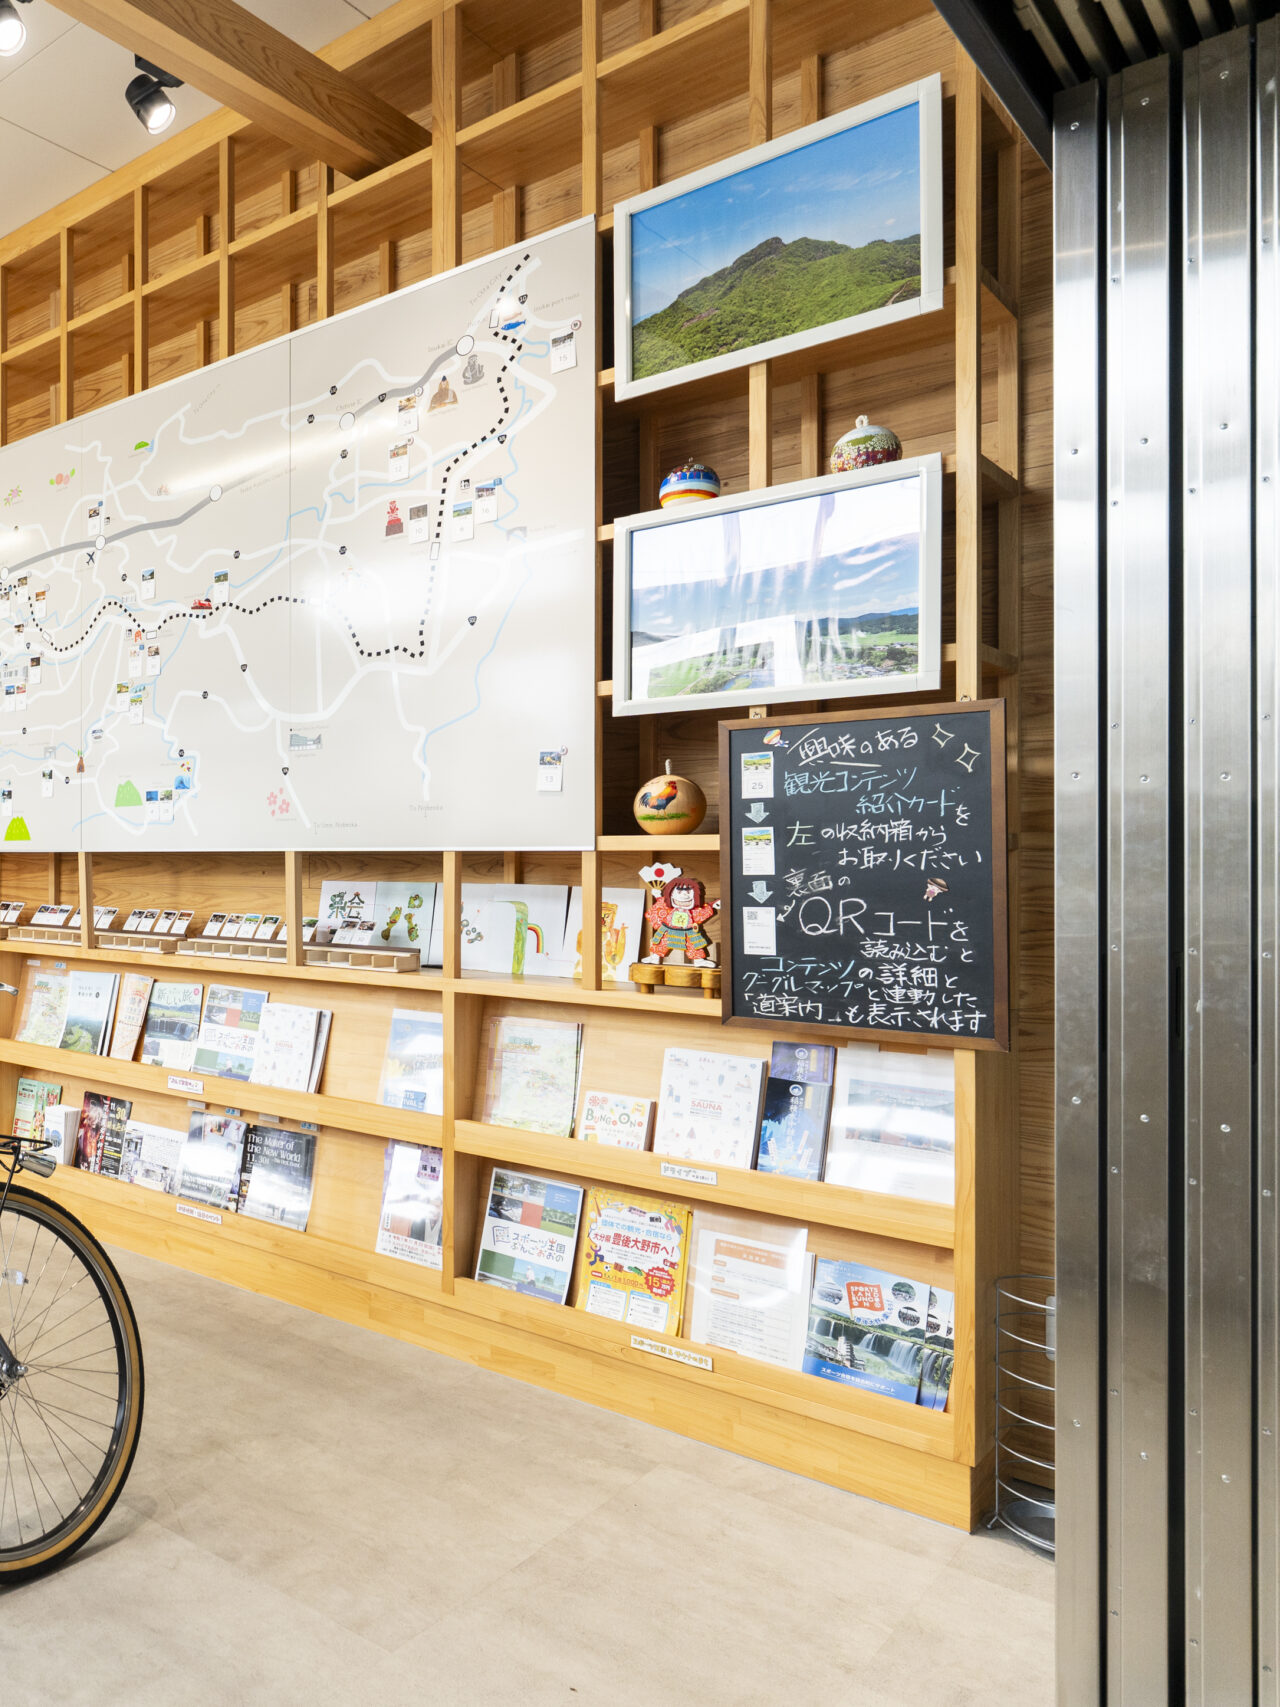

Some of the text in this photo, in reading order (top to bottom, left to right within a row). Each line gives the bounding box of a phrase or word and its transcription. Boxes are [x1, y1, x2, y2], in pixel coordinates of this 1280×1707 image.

[797, 727, 918, 766] 興味のある
[783, 767, 918, 796] 観光コンテンツ
[856, 787, 970, 826] 紹介カードを
[786, 818, 947, 848] 左の収納箱から
[837, 846, 982, 871] お取りください
[782, 867, 851, 898] 裏面の
[798, 896, 969, 941] QRコードを
[859, 937, 974, 963] 読み込むと
